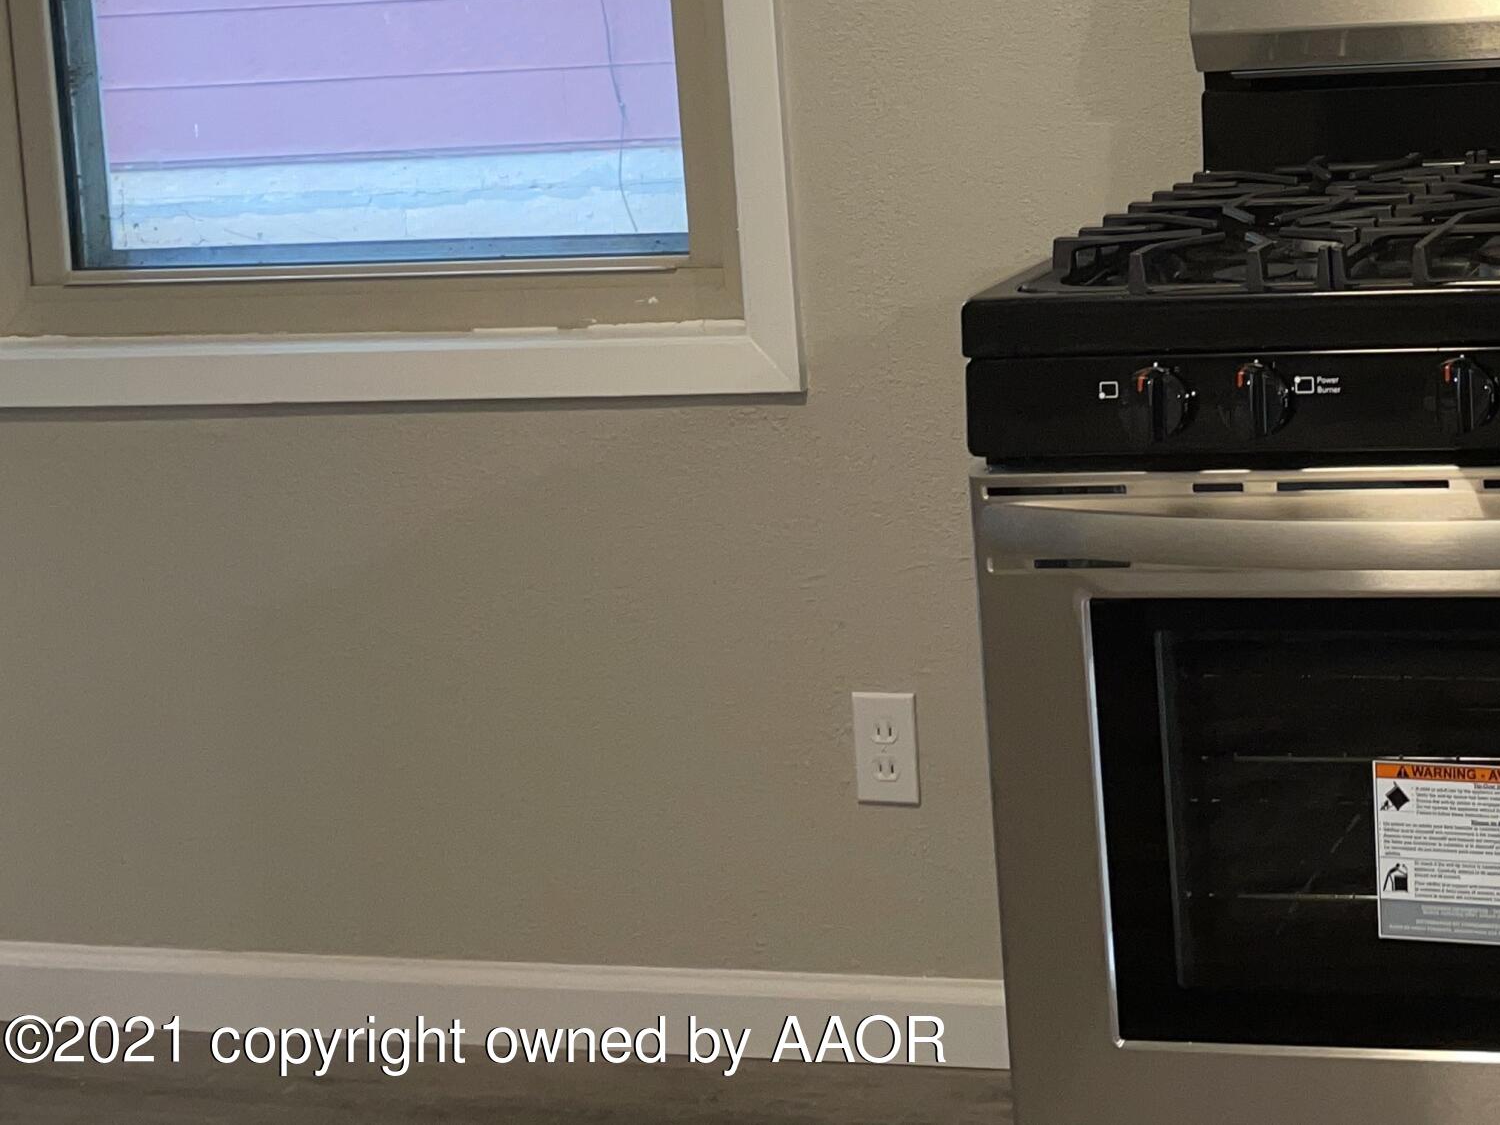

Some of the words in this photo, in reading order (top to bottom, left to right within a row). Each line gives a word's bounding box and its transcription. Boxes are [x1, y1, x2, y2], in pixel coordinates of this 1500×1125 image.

[1317, 376, 1339, 385] Power
[1317, 386, 1341, 394] Burner
[1412, 767, 1476, 781] WARNING
